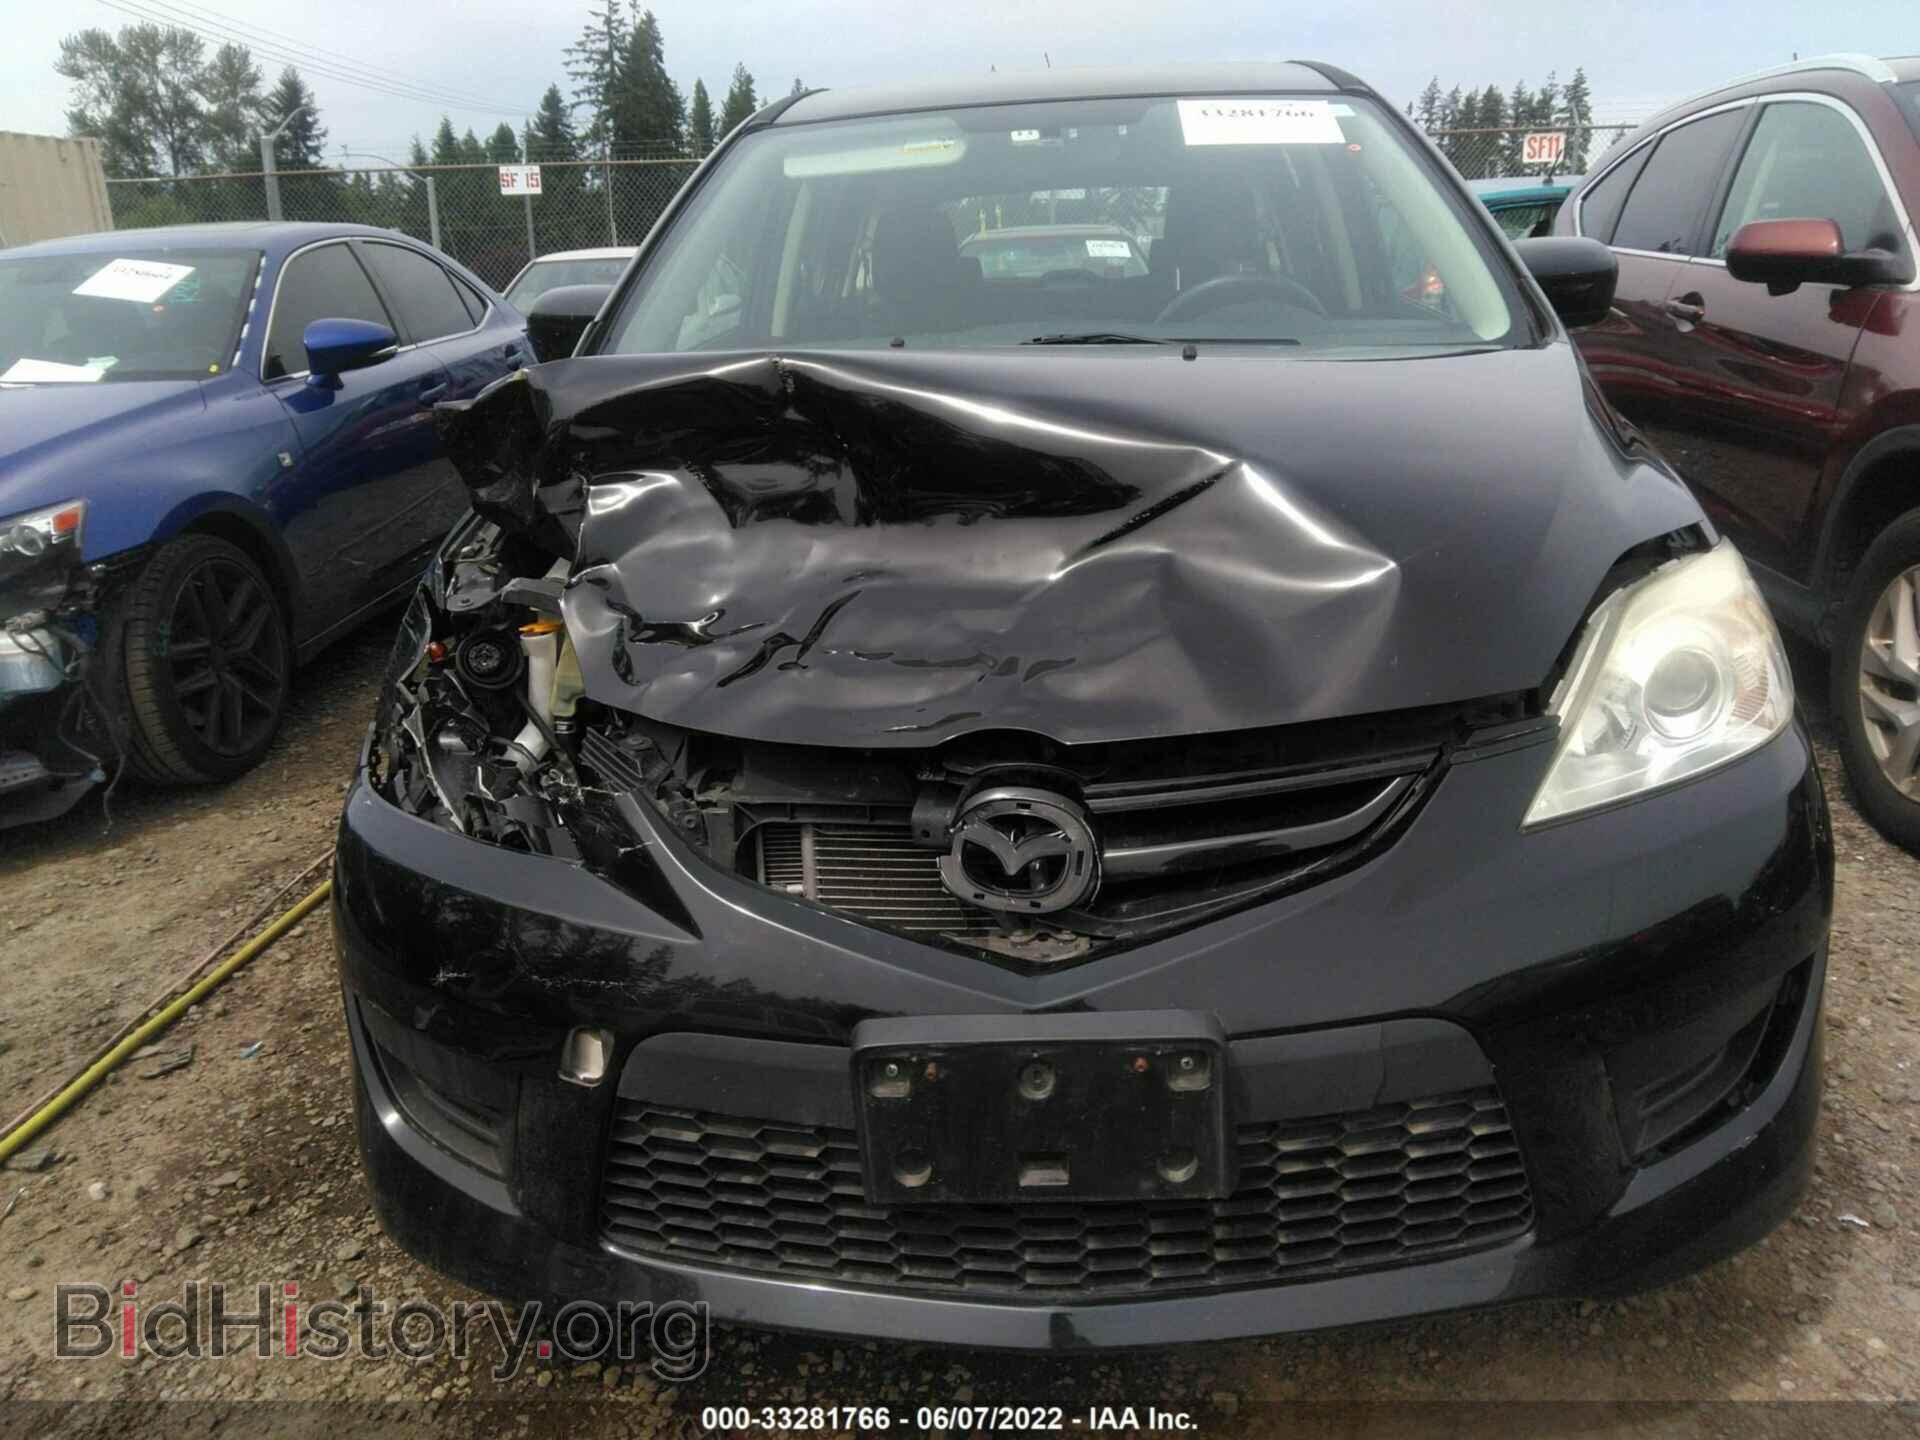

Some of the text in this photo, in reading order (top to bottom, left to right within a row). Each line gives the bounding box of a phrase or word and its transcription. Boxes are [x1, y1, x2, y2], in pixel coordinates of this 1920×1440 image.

[1526, 135, 1561, 160] SF11
[500, 172, 540, 188] SF 15
